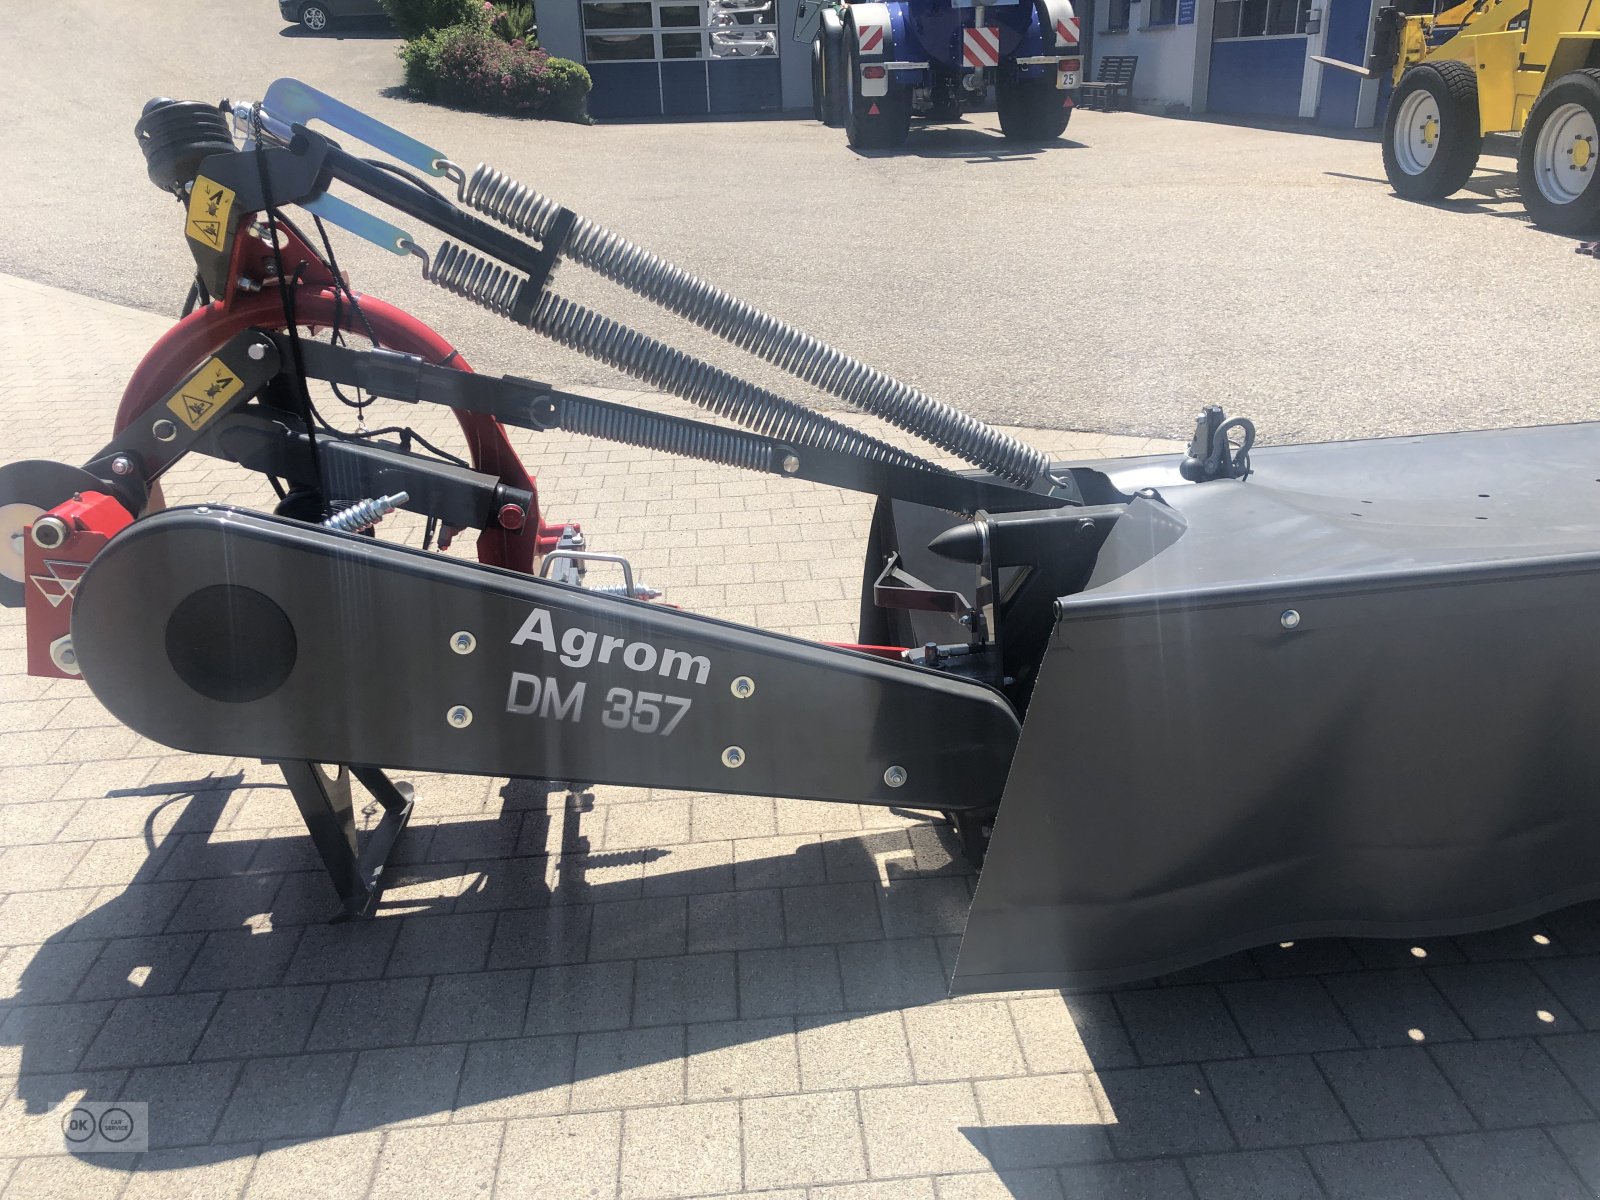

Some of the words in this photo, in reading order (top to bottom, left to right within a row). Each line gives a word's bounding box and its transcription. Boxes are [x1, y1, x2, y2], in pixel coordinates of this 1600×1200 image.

[1063, 73, 1074, 86] 25
[510, 607, 711, 684] Agrom
[506, 671, 587, 723] DM
[602, 687, 692, 736] 357
